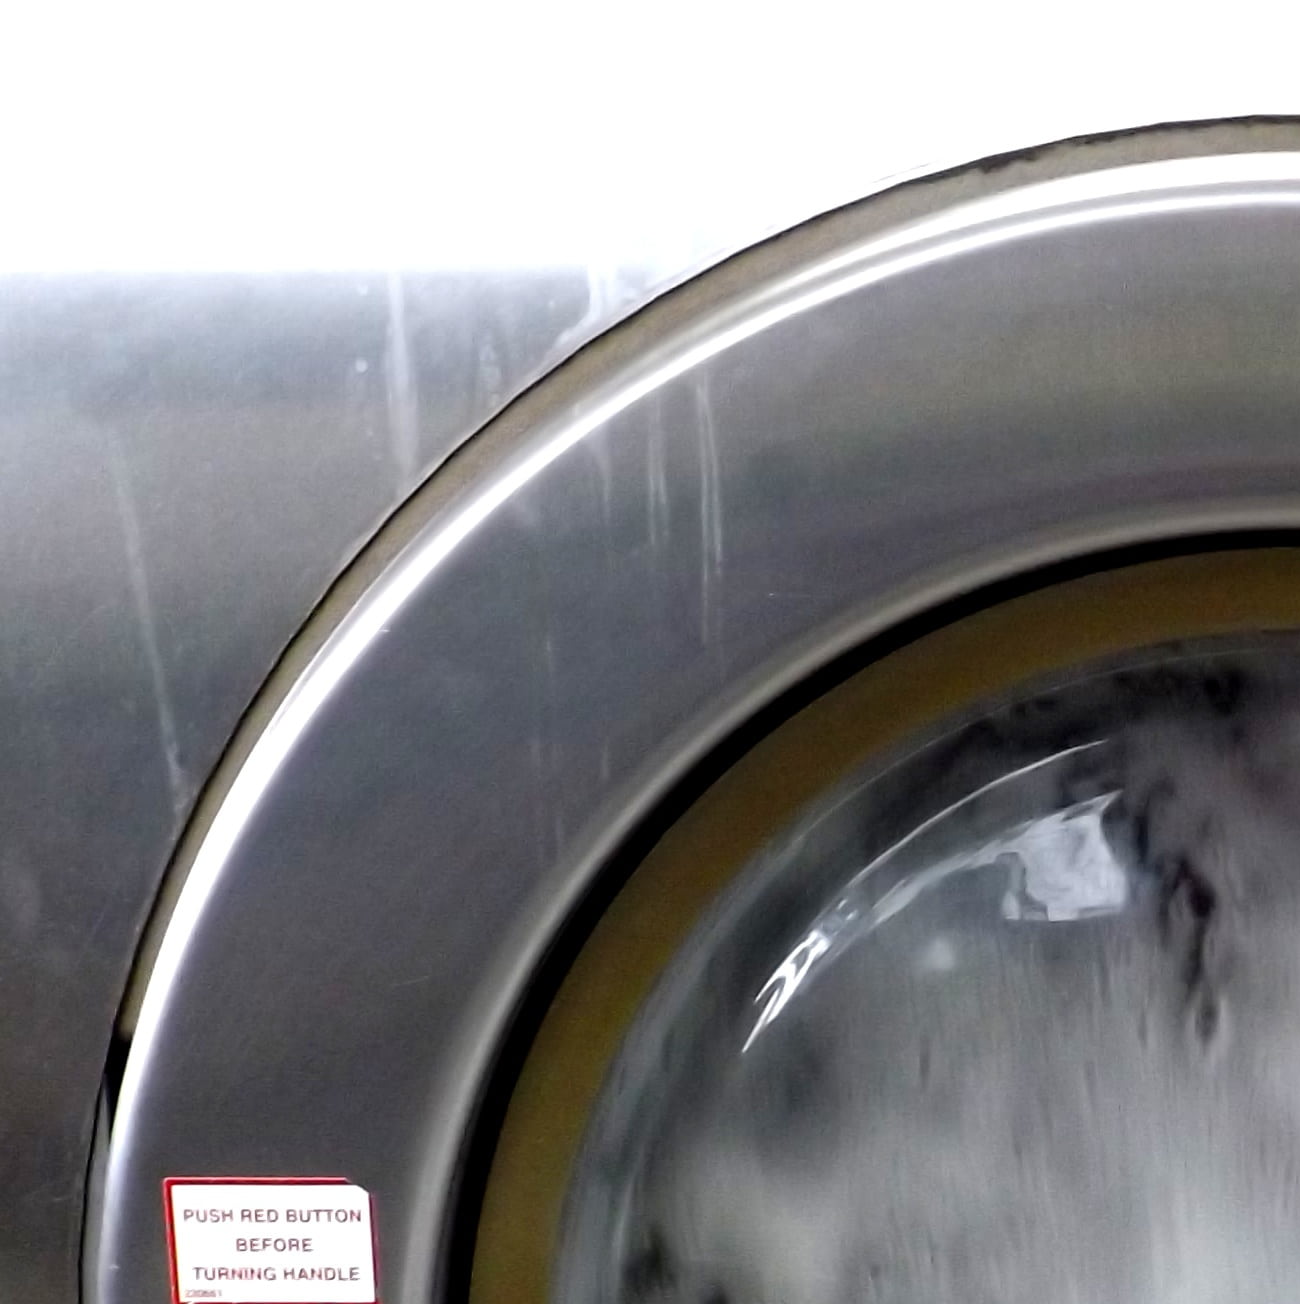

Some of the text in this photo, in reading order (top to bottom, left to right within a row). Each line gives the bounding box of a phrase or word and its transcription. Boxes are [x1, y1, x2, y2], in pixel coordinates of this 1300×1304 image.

[183, 1209, 361, 1223] PUSH RED BUTTON
[236, 1238, 314, 1252] BEFORE
[192, 1267, 360, 1281] TURNING HANDLE
